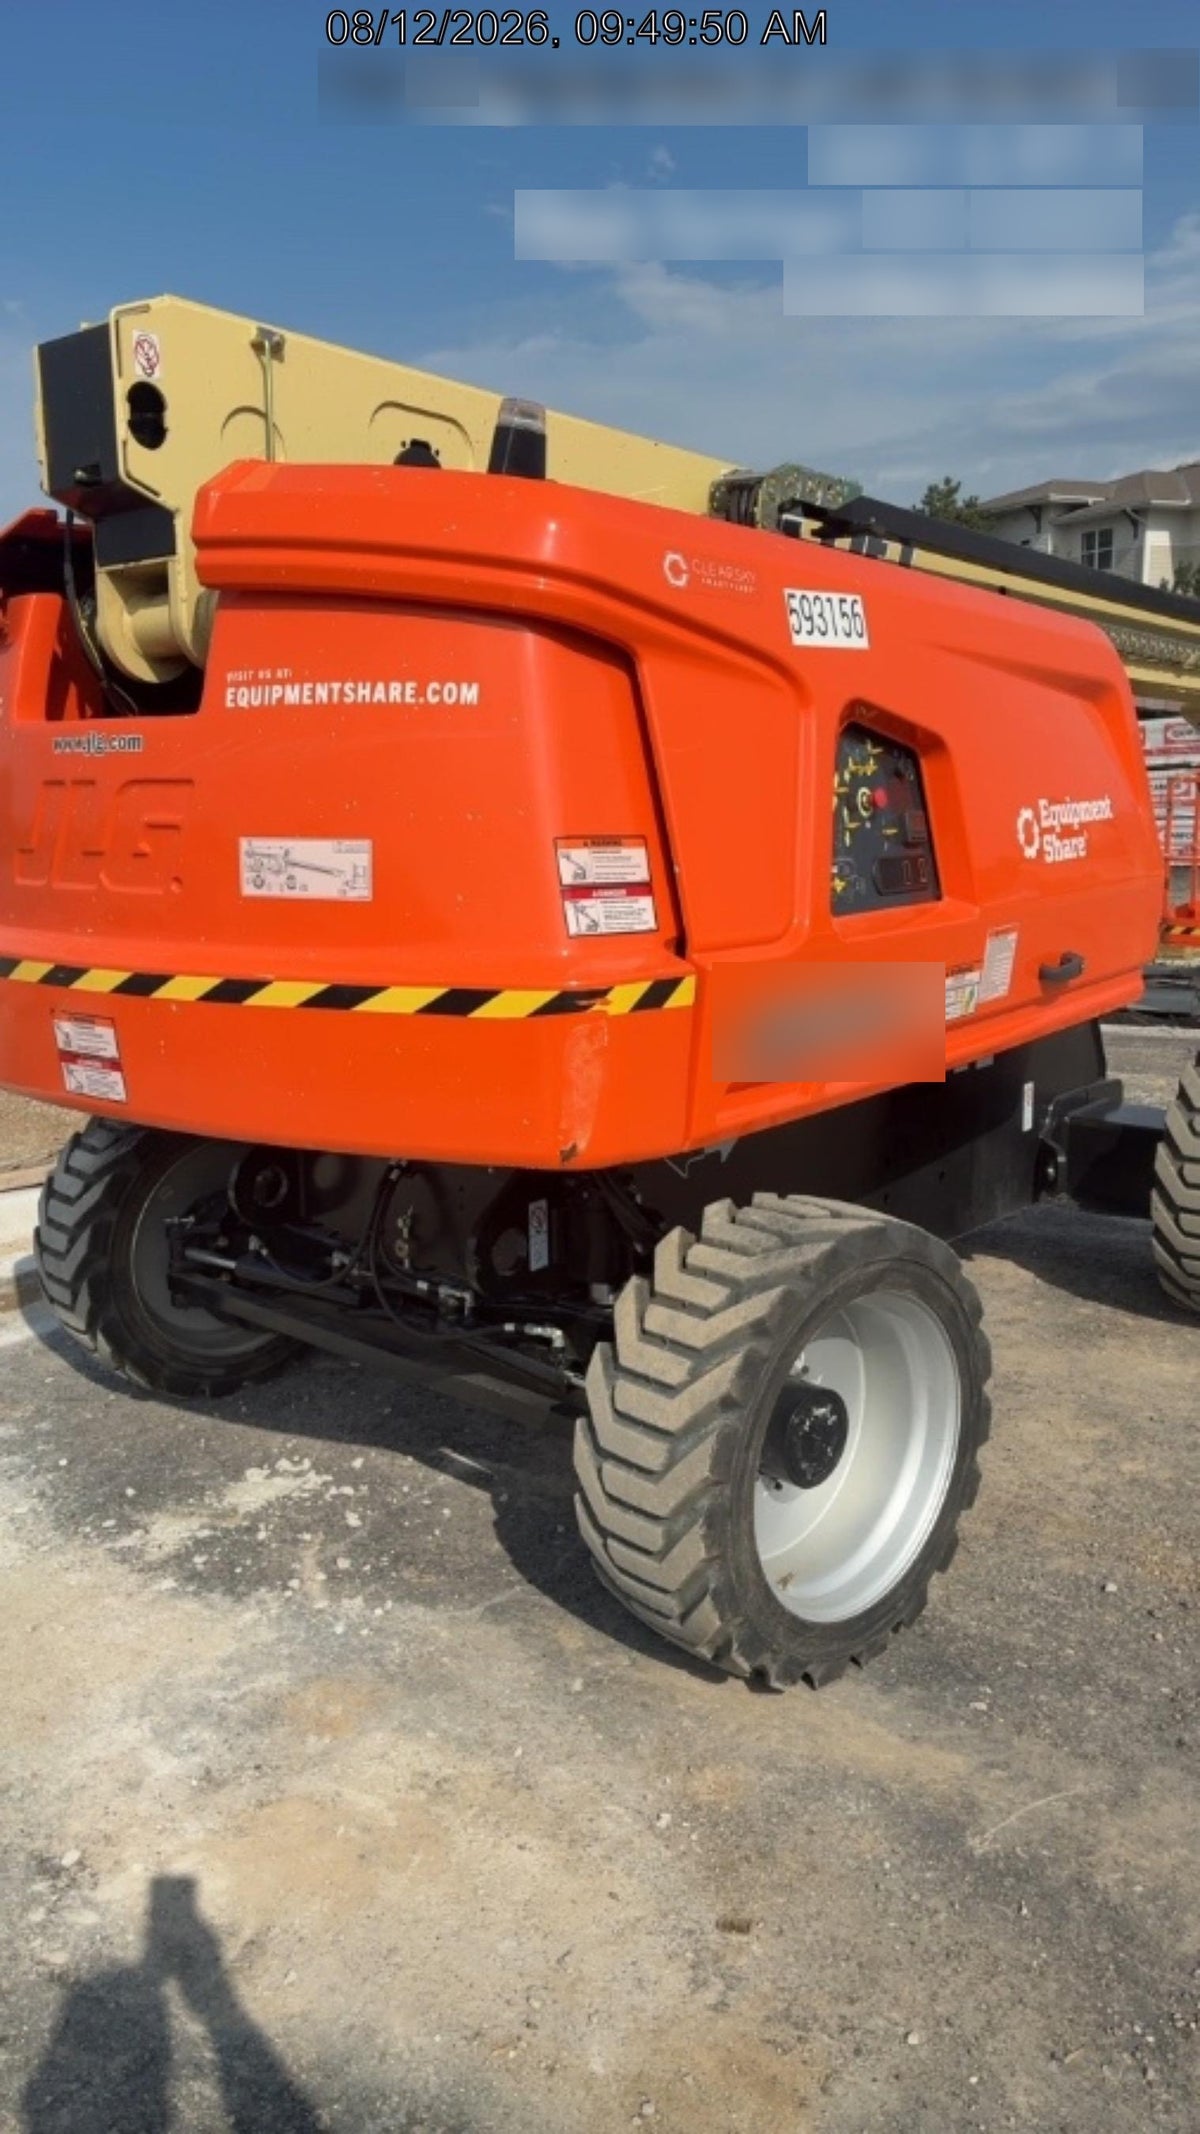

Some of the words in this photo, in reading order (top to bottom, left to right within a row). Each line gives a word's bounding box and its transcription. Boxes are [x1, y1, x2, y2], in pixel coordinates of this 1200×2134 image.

[787, 593, 864, 638] 593156
[225, 682, 479, 708] EQUIPMENTSHARE.COM
[53, 733, 142, 754] www.jlg.com
[1038, 795, 1113, 833] Equipment
[1043, 833, 1087, 863] Share
